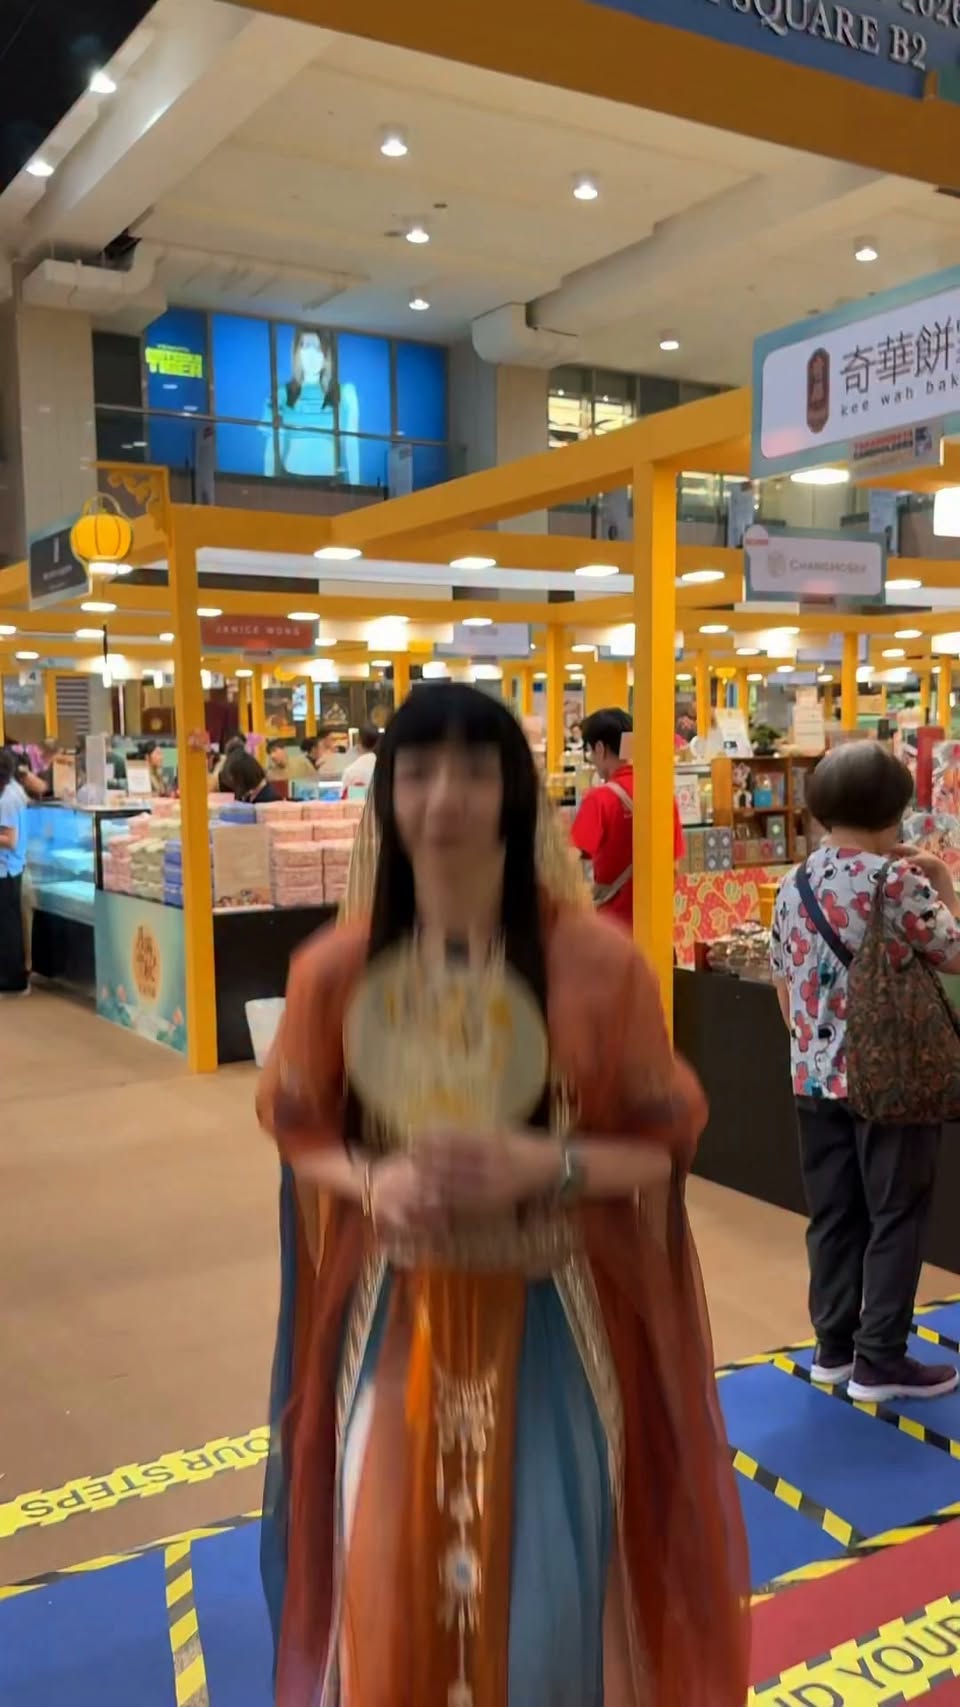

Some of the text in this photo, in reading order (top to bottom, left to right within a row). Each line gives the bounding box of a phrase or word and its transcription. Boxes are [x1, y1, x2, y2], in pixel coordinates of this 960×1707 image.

[889, 23, 928, 70] B2
[839, 315, 960, 394] 奇華餅
[841, 400, 870, 417] kee
[881, 386, 914, 406] wah
[21, 1465, 174, 1518] STEPS
